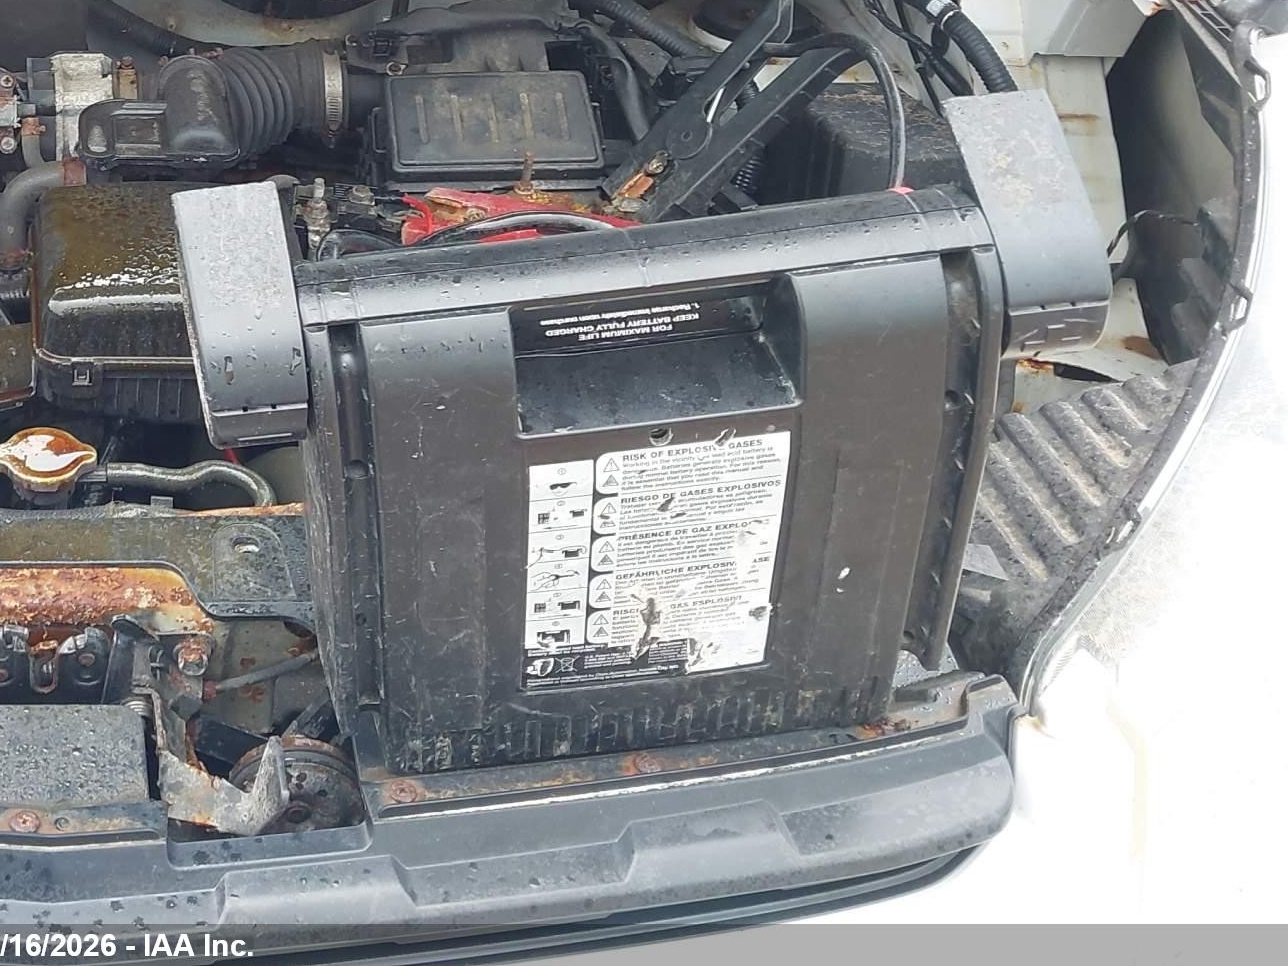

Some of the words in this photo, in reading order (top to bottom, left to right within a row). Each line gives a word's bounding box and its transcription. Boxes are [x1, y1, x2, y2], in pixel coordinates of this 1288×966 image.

[627, 316, 672, 328] BATTERY
[673, 313, 700, 322] KEEP
[545, 325, 596, 337] CHARGED
[596, 321, 626, 332] FULLY
[602, 326, 651, 338] MAXIMUM
[652, 323, 673, 332] FOR
[578, 333, 601, 341] LIFE
[623, 452, 647, 462] RISK
[651, 450, 663, 459] OF
[668, 444, 725, 457] EXPLOSI
[729, 438, 763, 450] GASES
[621, 494, 659, 504] RIESGO
[663, 491, 677, 500] DE
[680, 487, 713, 497] GASES
[717, 479, 782, 493] EXPLOSIVOS
[675, 528, 689, 536] DE
[692, 525, 713, 535] GAZ
[687, 560, 737, 573] EXPLOSIV
[670, 600, 690, 610] GAS
